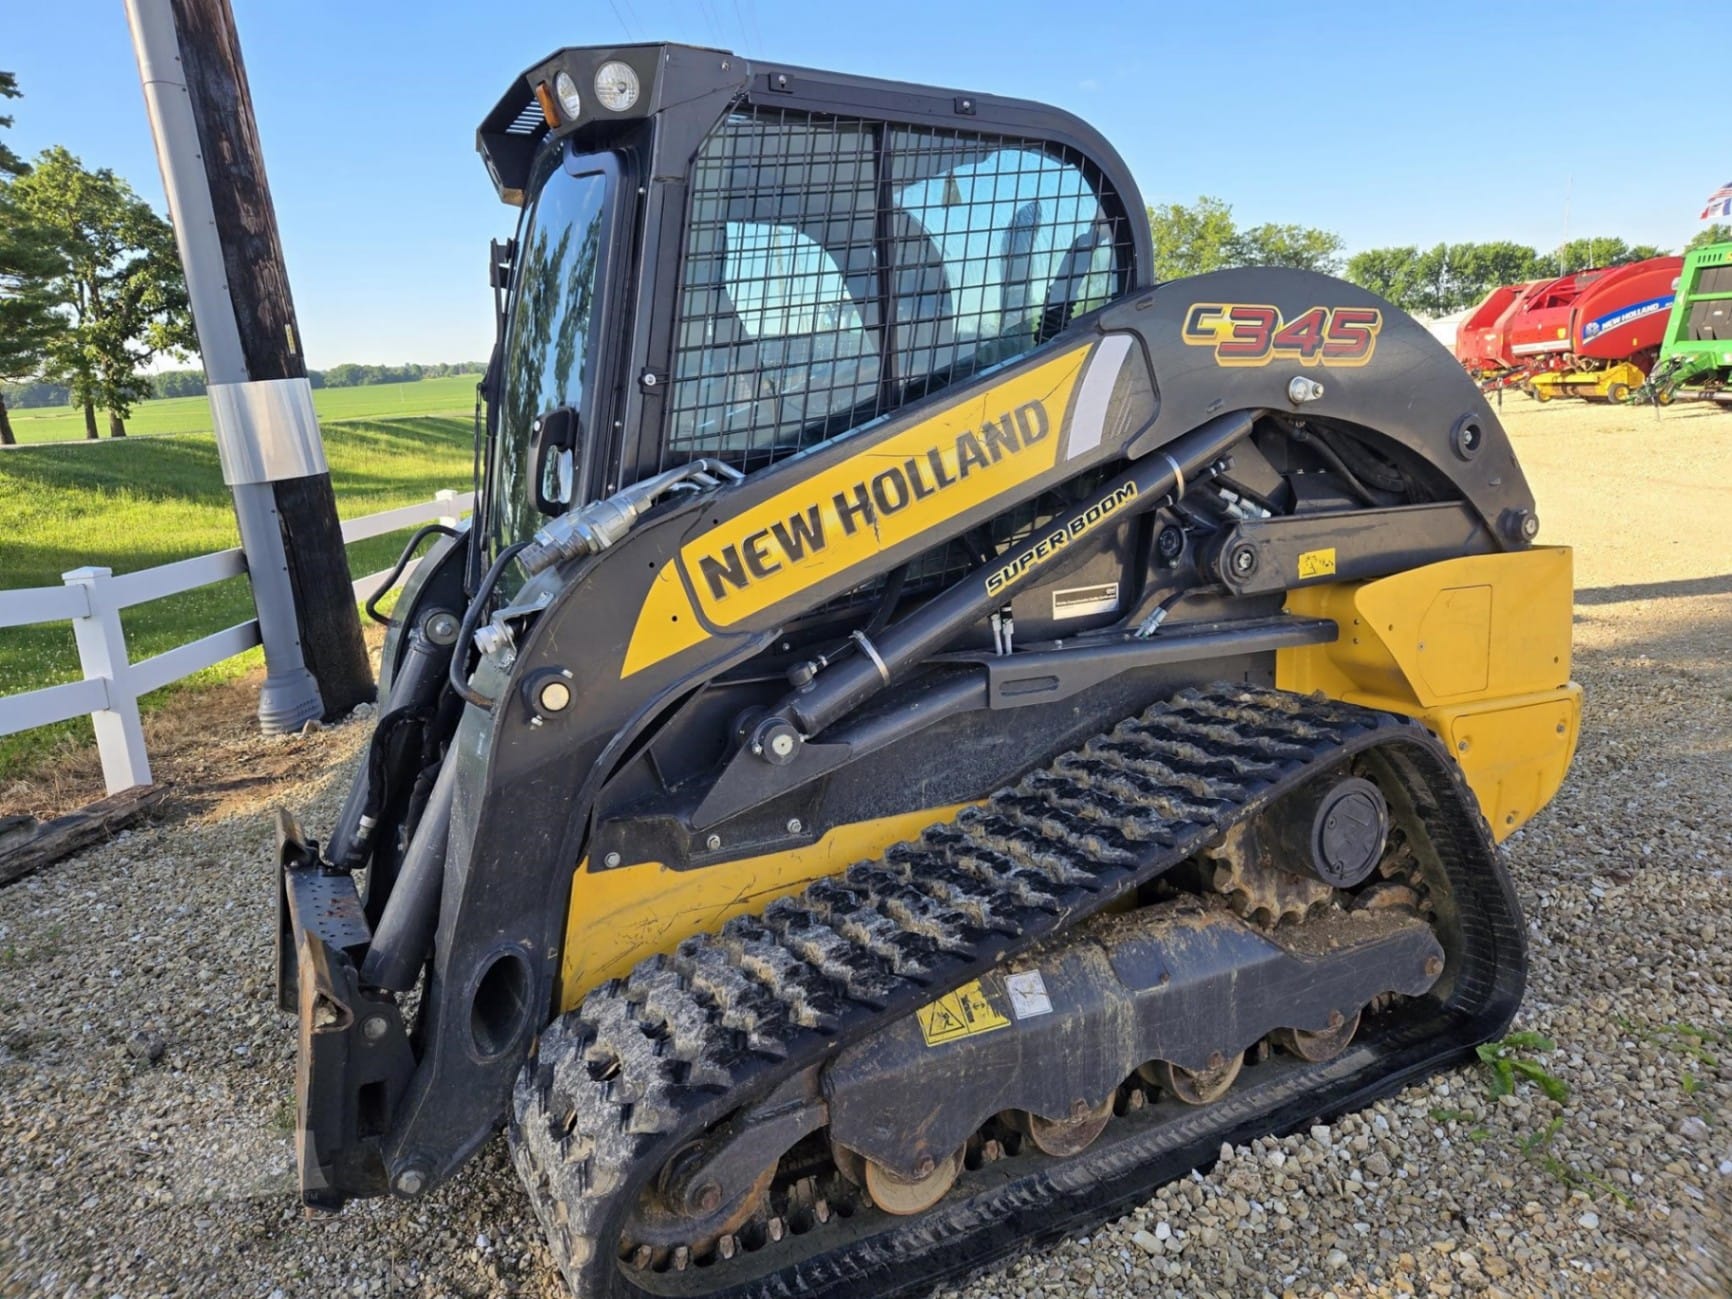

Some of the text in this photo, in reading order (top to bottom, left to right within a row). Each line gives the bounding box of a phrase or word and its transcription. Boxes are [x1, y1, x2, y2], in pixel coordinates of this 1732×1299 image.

[1182, 303, 1383, 367] C345
[1601, 316, 1621, 330] NEW
[1622, 302, 1660, 321] HOLLAND
[698, 399, 1050, 602] NEW HOLLAND
[986, 482, 1137, 596] SUPER BOOM
